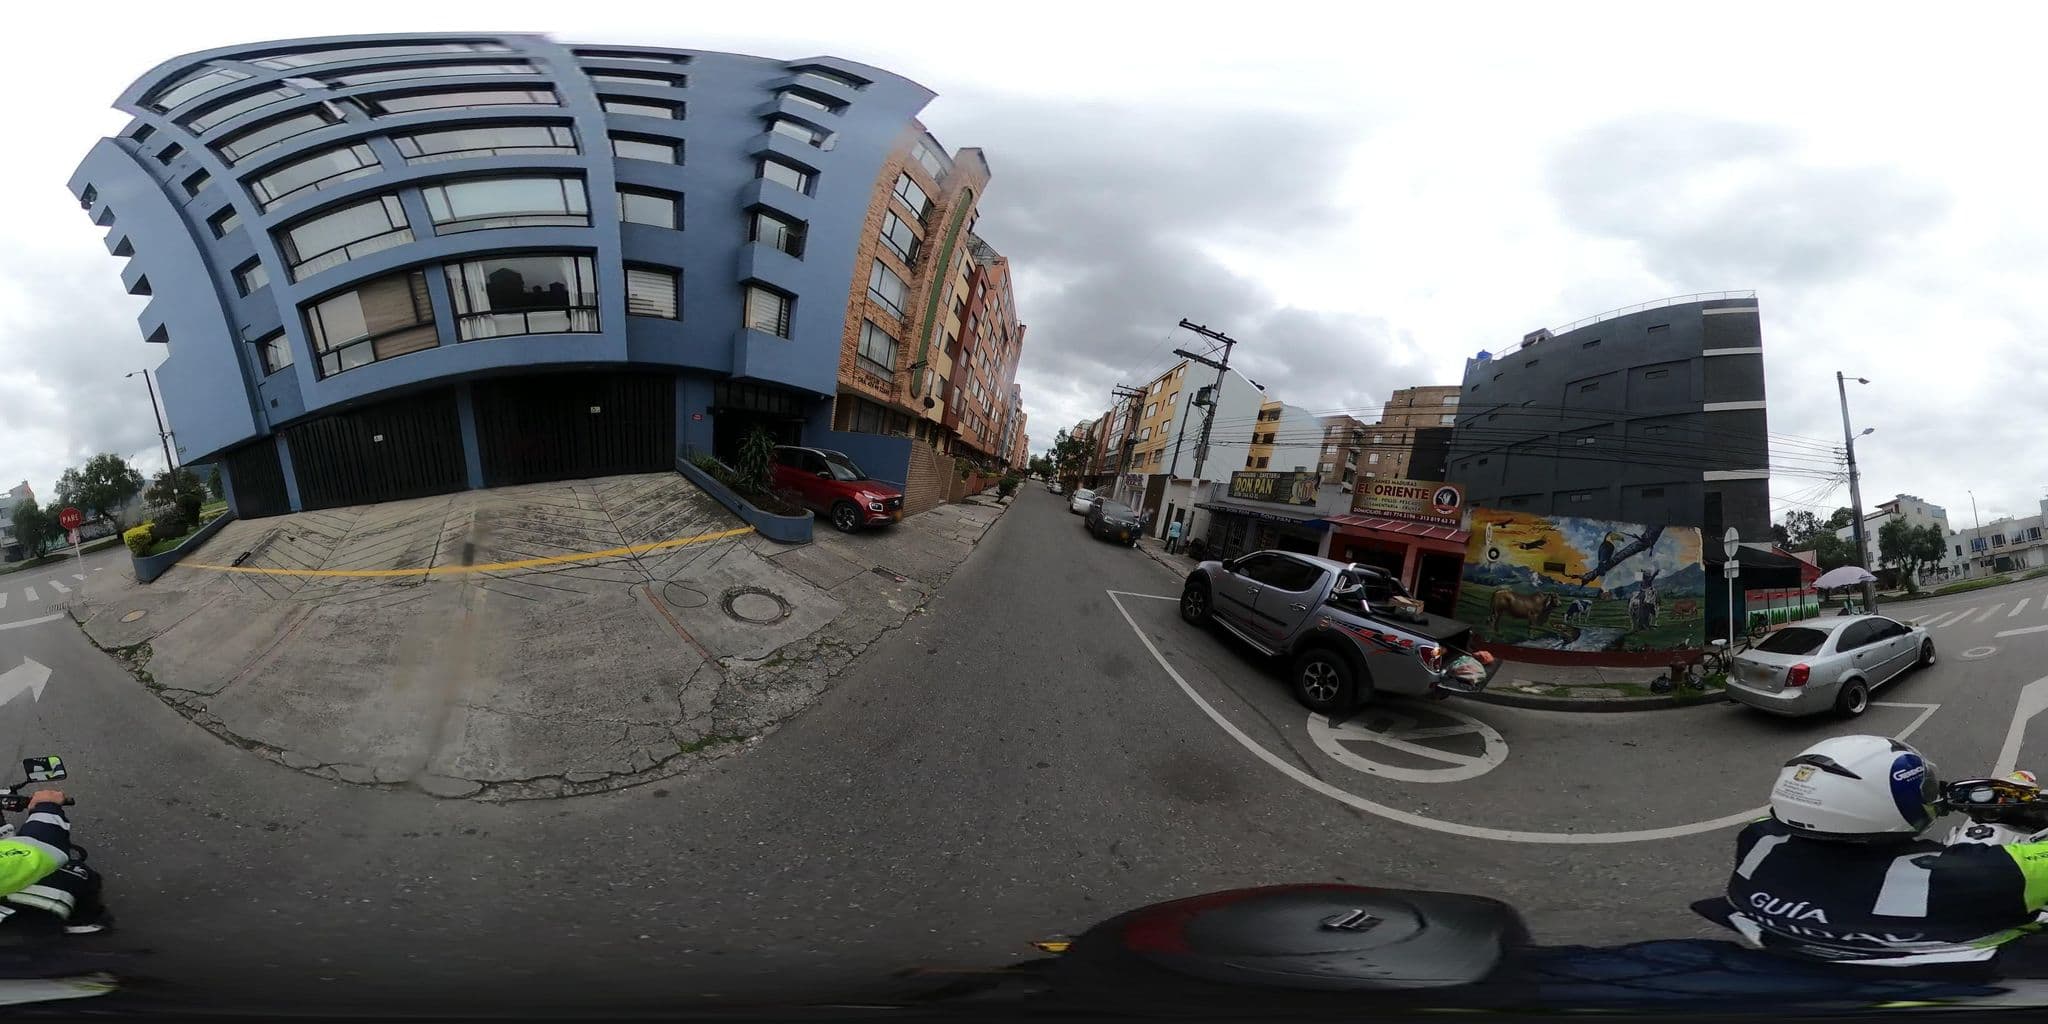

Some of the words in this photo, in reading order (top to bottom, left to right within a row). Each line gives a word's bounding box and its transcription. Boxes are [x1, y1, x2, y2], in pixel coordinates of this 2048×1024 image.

[1235, 477, 1254, 492] DON
[1254, 478, 1274, 494] PAN
[1357, 483, 1371, 494] EL
[1374, 485, 1430, 500] ORIENTE
[62, 513, 79, 523] PARE
[1750, 892, 1829, 924] GUÍA
